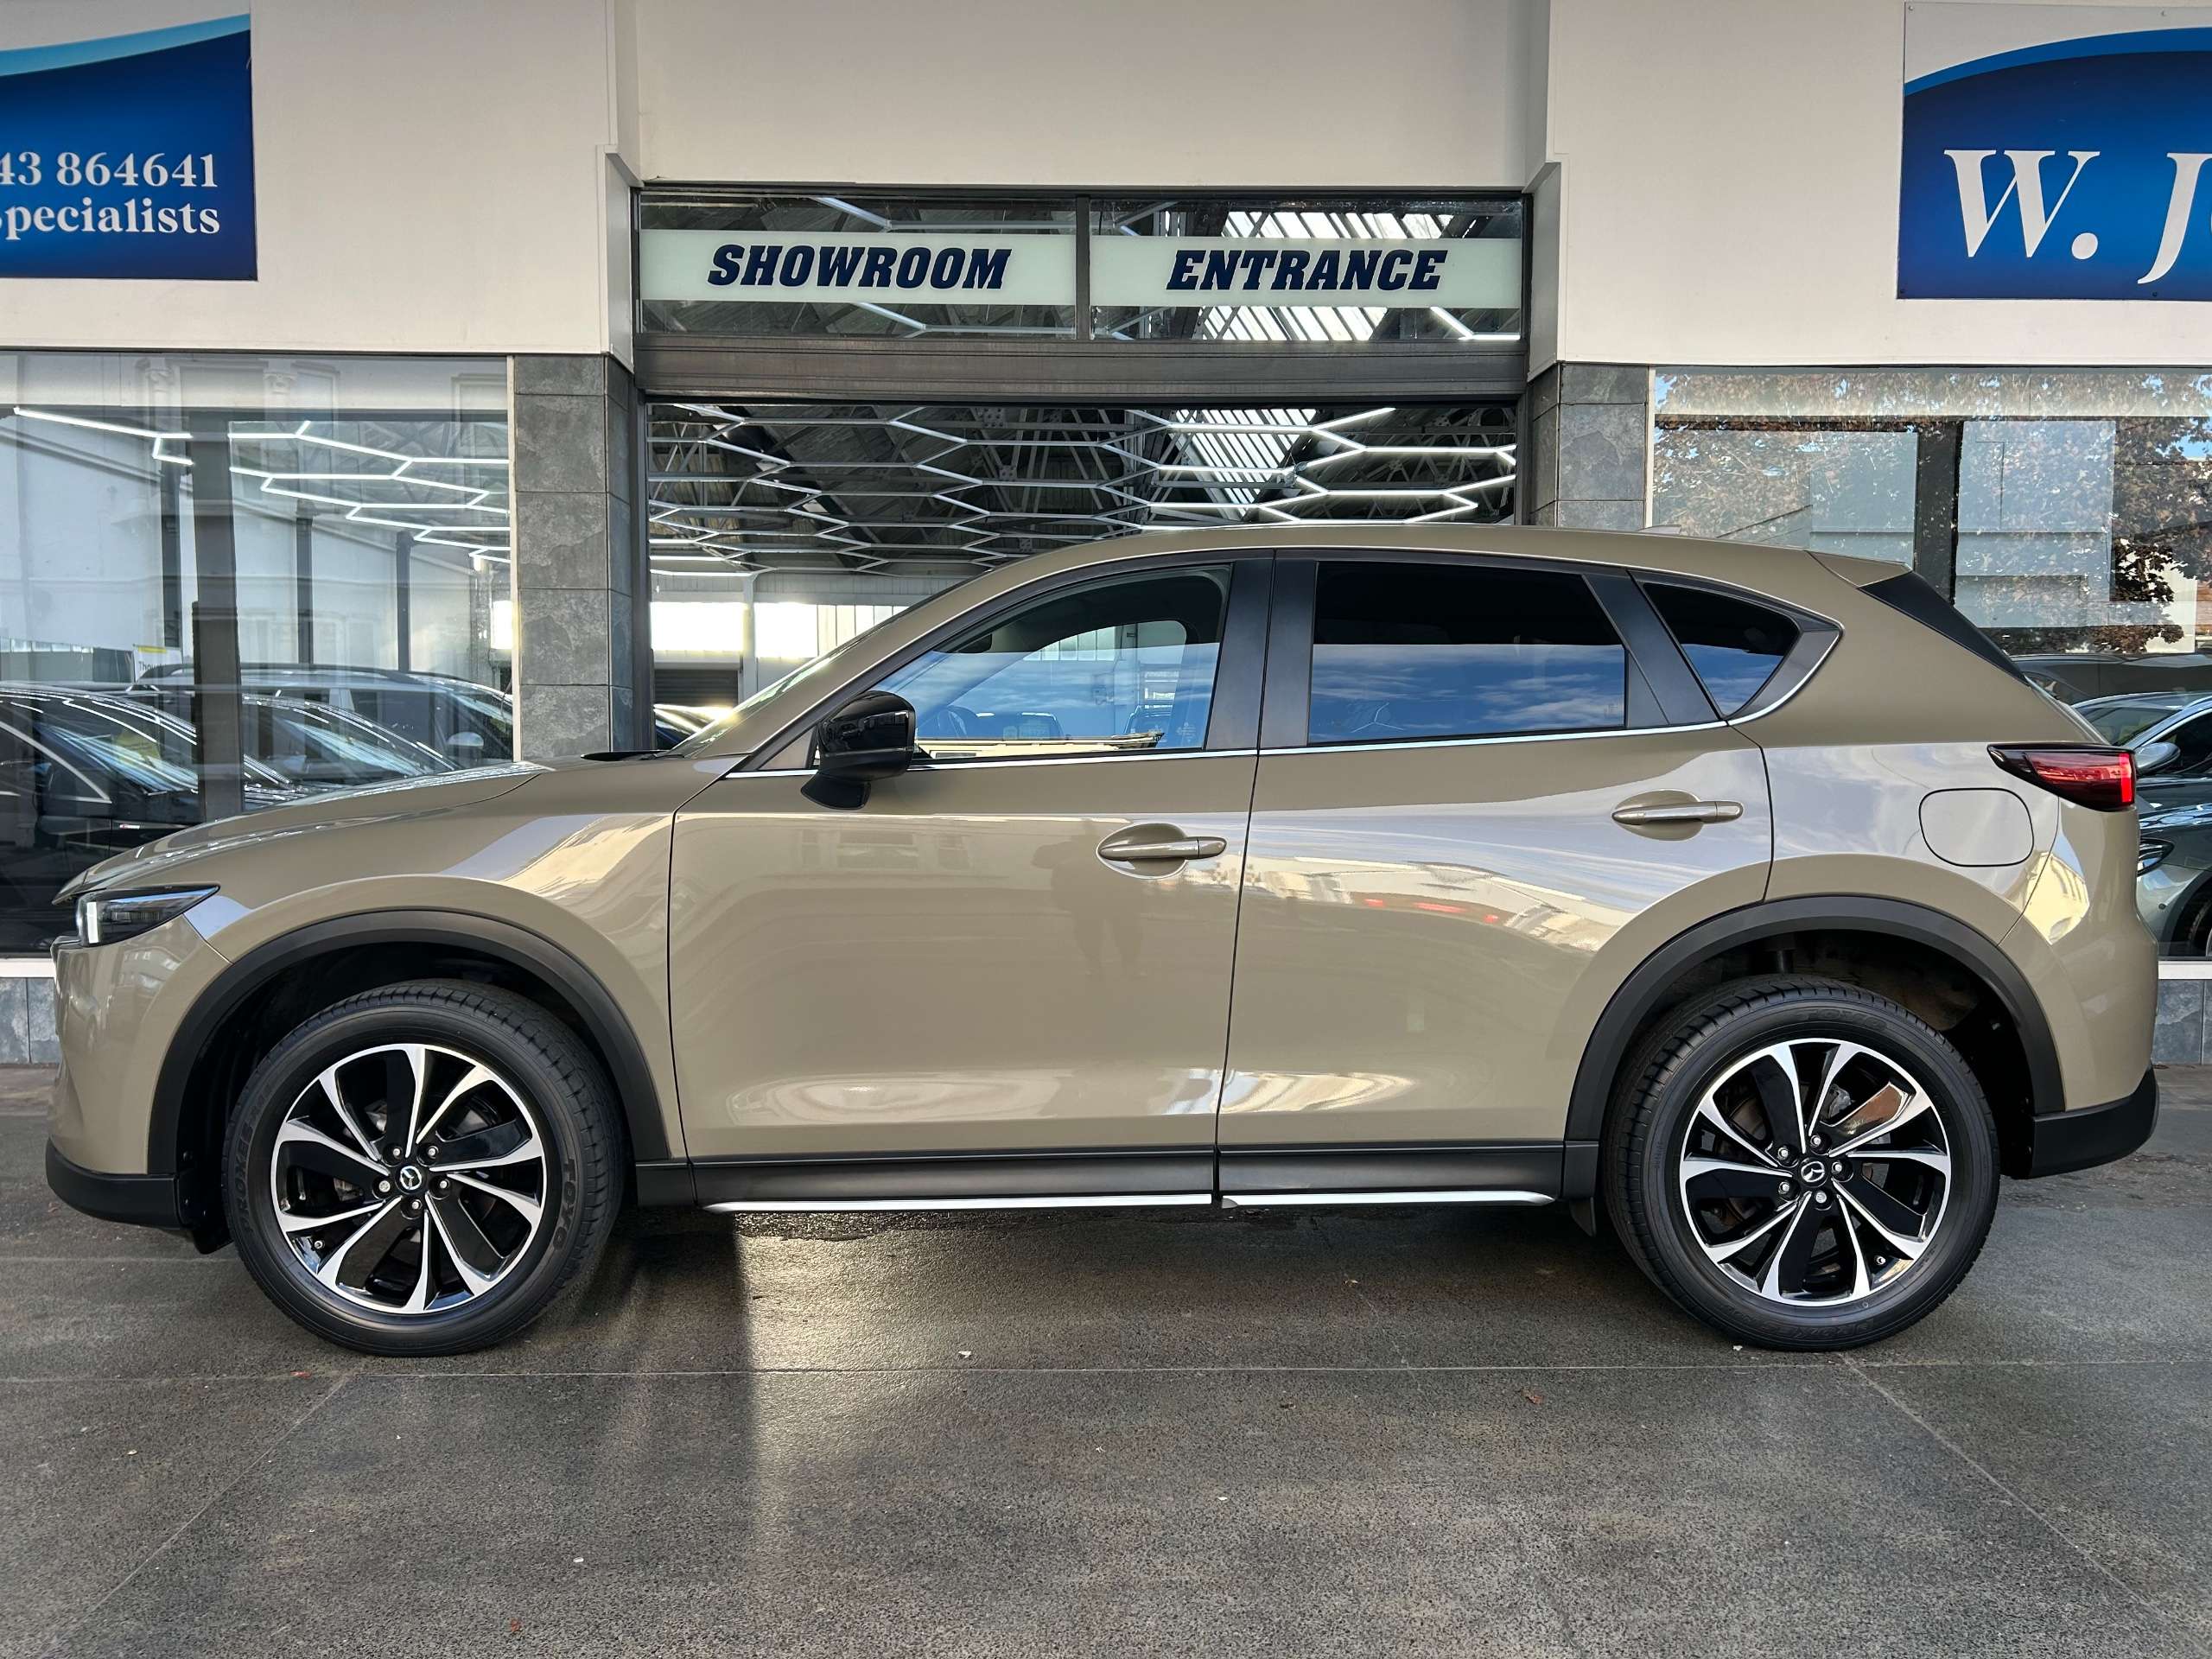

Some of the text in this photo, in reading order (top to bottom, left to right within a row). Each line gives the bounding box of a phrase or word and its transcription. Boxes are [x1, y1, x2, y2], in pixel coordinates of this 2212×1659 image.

[56, 152, 218, 188] 864641
[1943, 149, 2212, 284] W. J
[707, 244, 1013, 290] SHOWROOM
[1166, 249, 1449, 292] ENTRANCE
